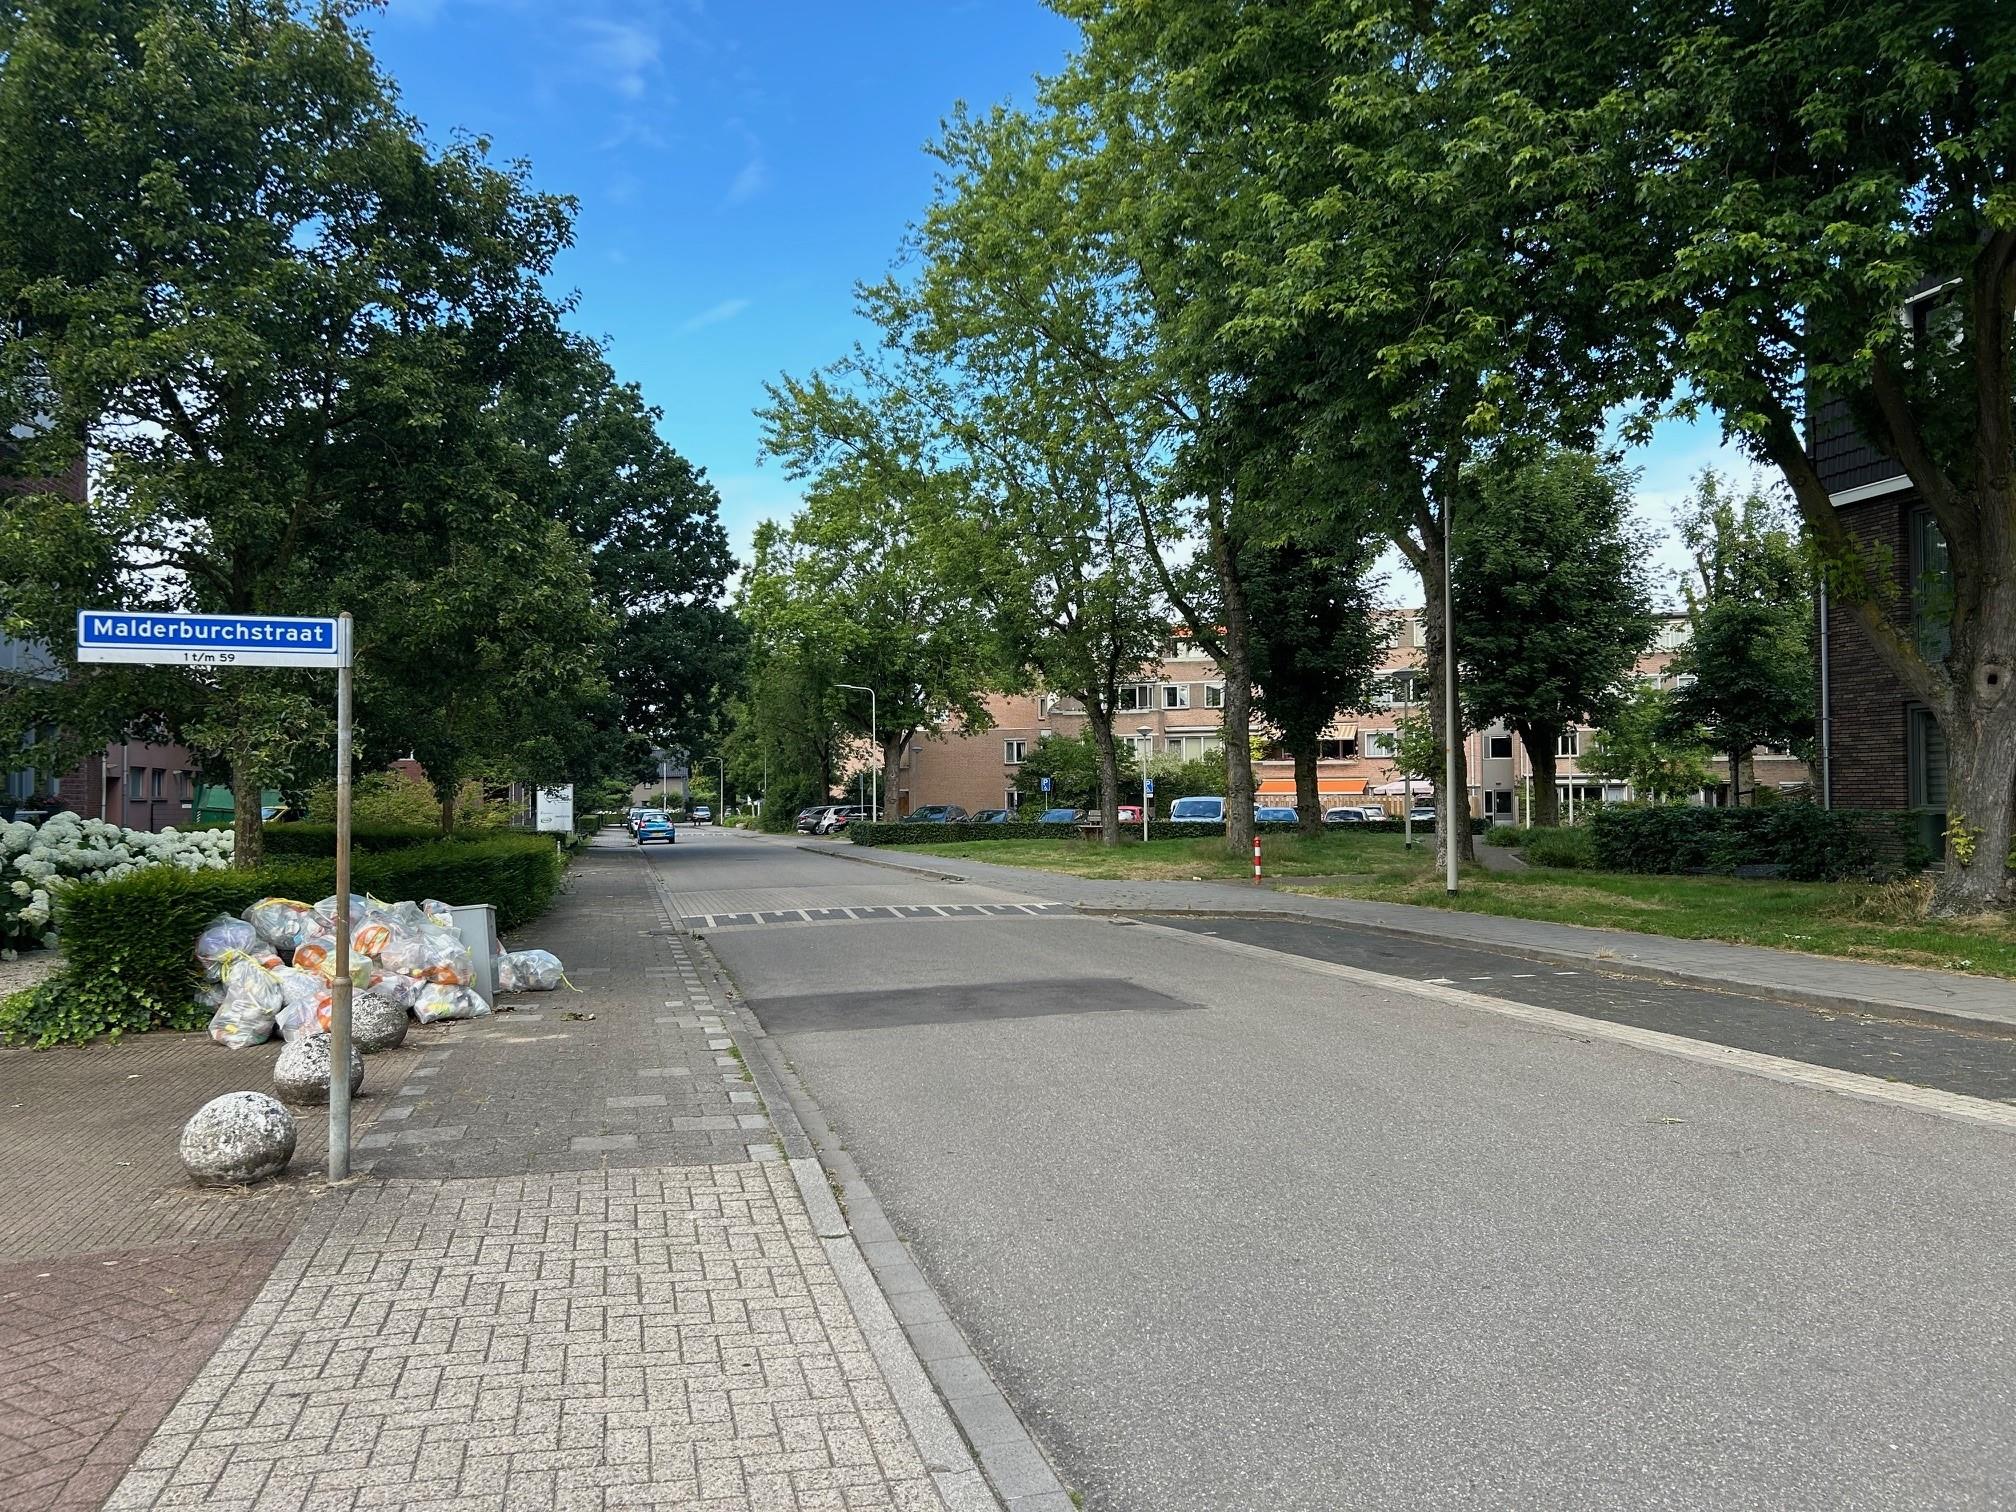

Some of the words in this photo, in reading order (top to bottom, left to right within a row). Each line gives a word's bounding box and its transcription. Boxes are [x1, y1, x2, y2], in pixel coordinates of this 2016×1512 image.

[93, 618, 323, 642] Malderburchstraat
[184, 653, 189, 661] 1
[192, 652, 215, 662] t/m
[219, 653, 236, 662] 59
